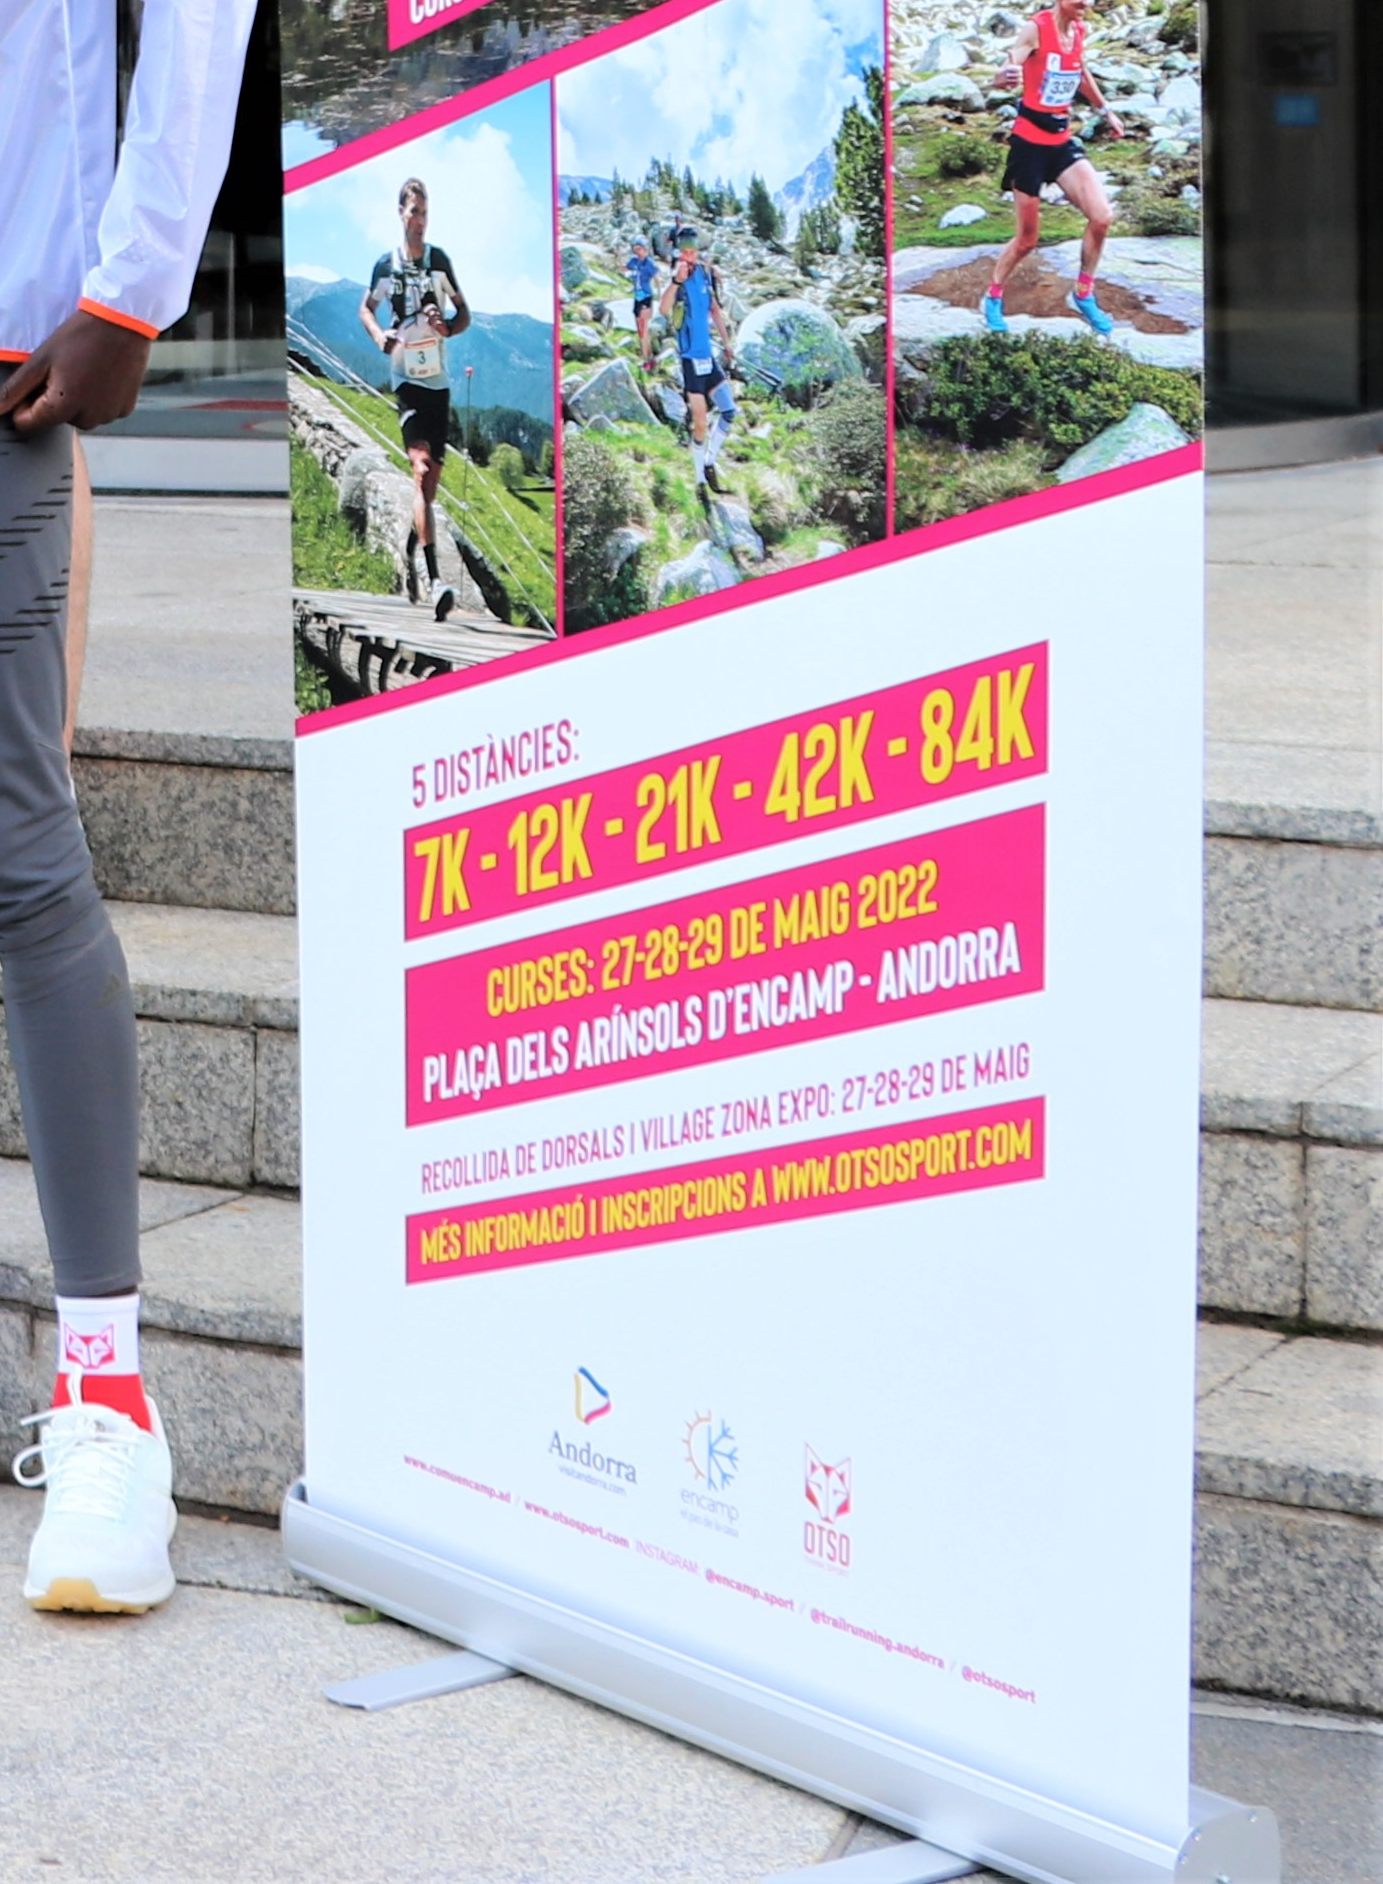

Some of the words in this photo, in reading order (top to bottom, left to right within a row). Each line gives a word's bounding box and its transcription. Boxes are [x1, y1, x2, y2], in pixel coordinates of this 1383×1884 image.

[417, 351, 426, 364] 3
[412, 763, 426, 808] 5
[434, 719, 580, 802] DISTÀNCIES:
[414, 828, 471, 921] 7K
[507, 792, 593, 895] 12K
[635, 754, 722, 865] 21K
[764, 710, 875, 824] 42K
[919, 662, 1035, 785] 84K
[486, 946, 595, 1018] CURSES:
[601, 917, 723, 992] 27-28-29
[730, 902, 767, 959] DE
[772, 881, 850, 951] MAIG
[858, 859, 938, 928] 2022
[423, 1040, 502, 1103] PLAÇA
[506, 1025, 569, 1085] DELS
[575, 995, 702, 1070] ARÍNSOLS
[708, 960, 854, 1041] D'ENCAMP
[877, 922, 1021, 1003] ANDORRA
[420, 1217, 461, 1265] MÉS
[464, 1193, 587, 1257] INFORMACIÓ
[589, 1200, 597, 1238] I
[601, 1171, 746, 1234] INSCRIPCIONS
[750, 1169, 768, 1207] A
[771, 1118, 1033, 1205] WWW.OTSOSPORT.COM
[421, 1148, 511, 1195] RECOLLIDA
[515, 1143, 536, 1175] DE
[541, 1123, 625, 1171] DORSALS
[641, 1103, 716, 1153] VILLAGE
[720, 1092, 773, 1137] ZONA
[777, 1081, 837, 1127] EXPO:
[841, 1062, 934, 1112] 27-28-29
[940, 1055, 967, 1093] DE
[972, 1042, 1031, 1087] MAIG
[548, 1429, 638, 1485] Andorra
[680, 1488, 740, 1526] encamp
[403, 1454, 511, 1504] www.comuencamp.ad
[524, 1499, 630, 1549] www.otsosport.com
[705, 1568, 795, 1611] @encamp.sport
[810, 1607, 945, 1670] @trailrunning.andorra
[961, 1665, 1036, 1704] @otsosport
[804, 1520, 850, 1567] OTSO
